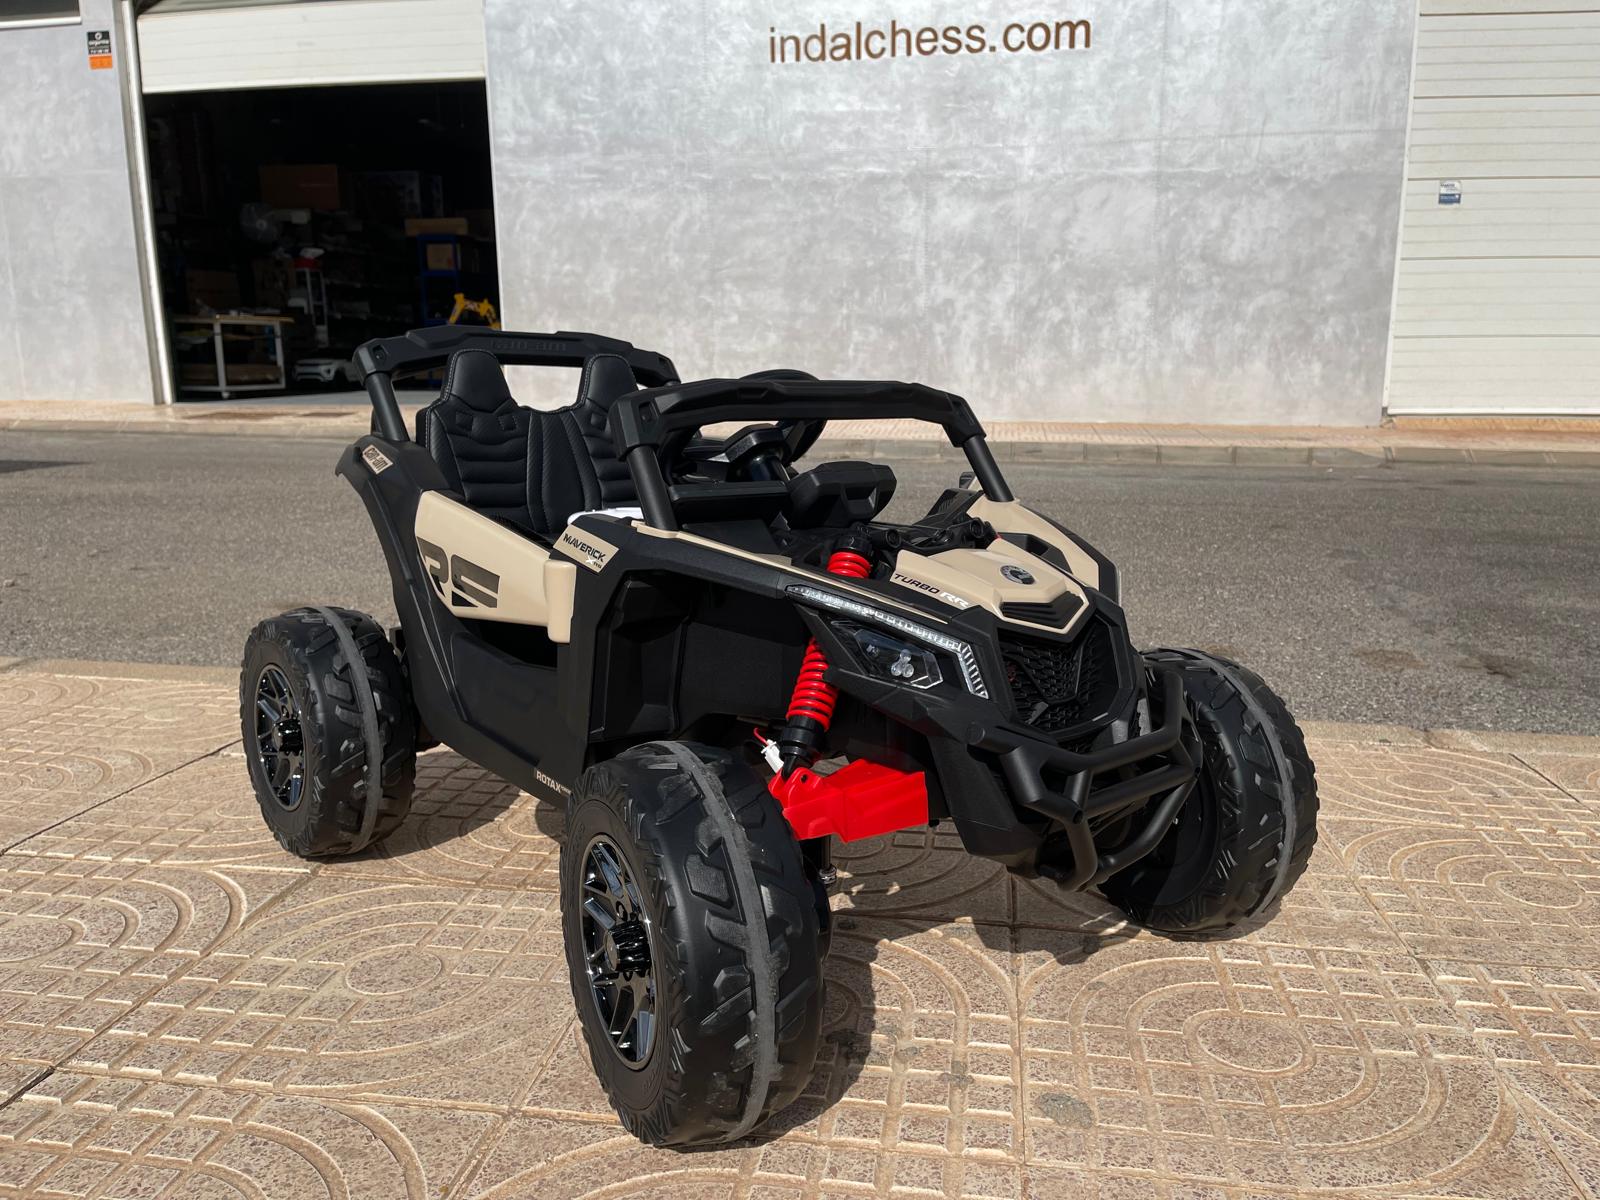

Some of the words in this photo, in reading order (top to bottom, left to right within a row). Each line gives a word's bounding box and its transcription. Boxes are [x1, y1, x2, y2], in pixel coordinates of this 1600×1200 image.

[769, 19, 1091, 63] indalchess.com
[563, 533, 606, 562] MAVERICK
[894, 573, 940, 594] TURBO
[940, 591, 970, 608] RR
[536, 770, 561, 793] ROTAX
